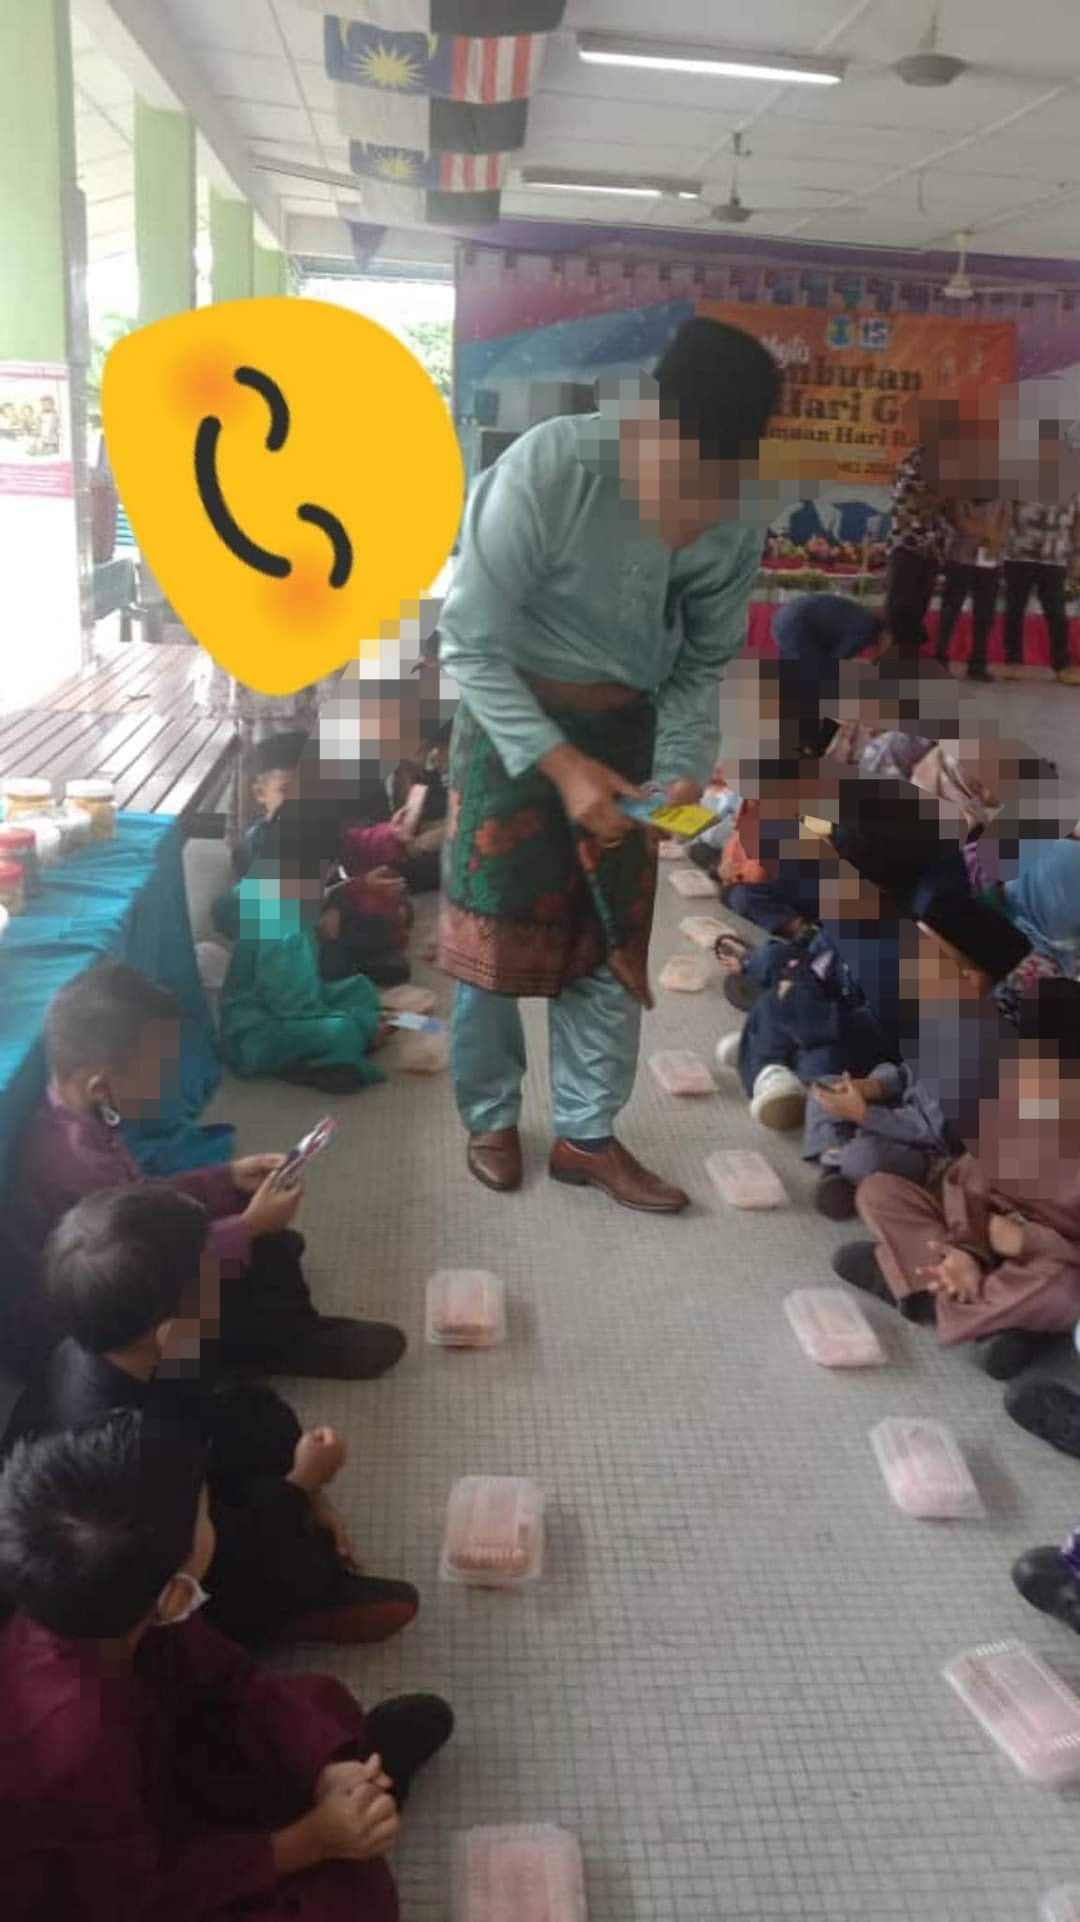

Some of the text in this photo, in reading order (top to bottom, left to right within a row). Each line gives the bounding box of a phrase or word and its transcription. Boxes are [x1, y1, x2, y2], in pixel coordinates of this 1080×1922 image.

[777, 356, 921, 391] mbutan
[873, 396, 900, 423] G
[836, 427, 886, 446] Hari
